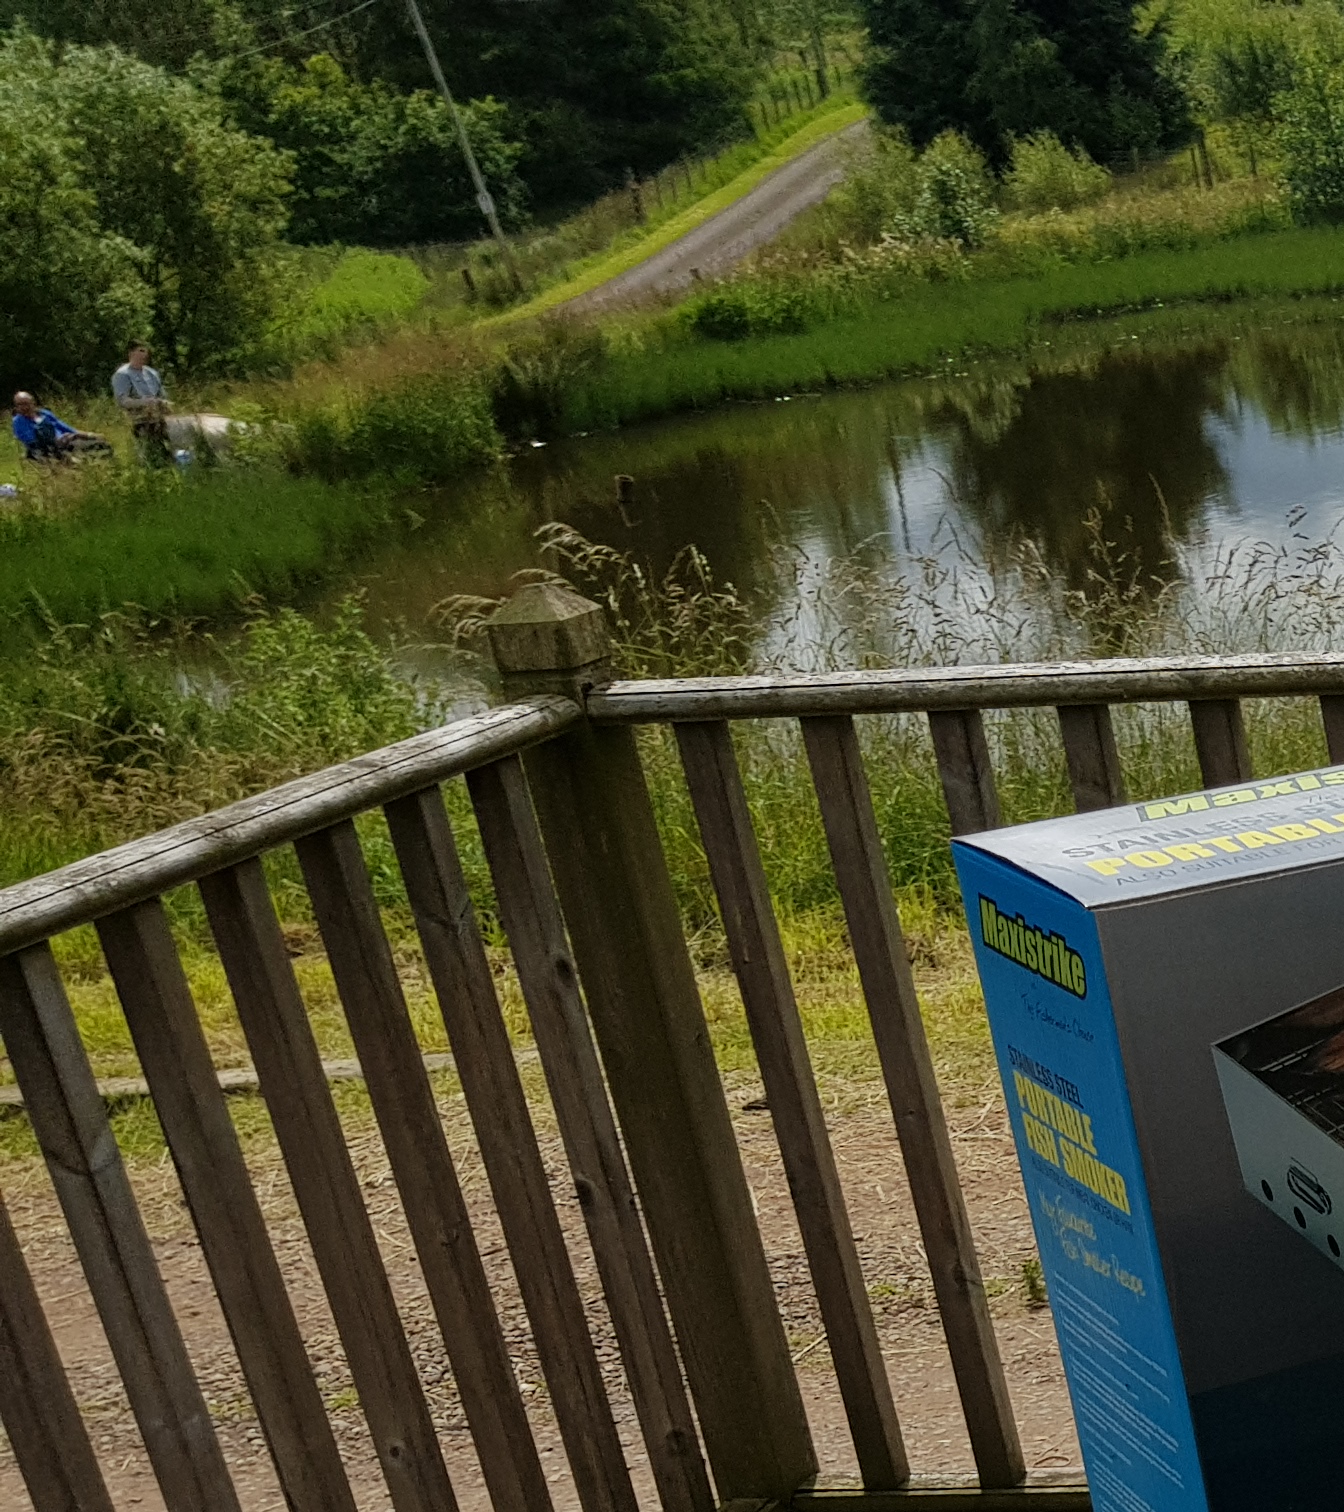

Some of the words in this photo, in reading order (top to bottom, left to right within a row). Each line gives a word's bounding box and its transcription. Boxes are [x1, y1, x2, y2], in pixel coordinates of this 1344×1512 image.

[1061, 811, 1288, 859] STAINLESS
[1115, 868, 1178, 887] ALSO
[1182, 847, 1291, 874] SUITABLE
[1296, 836, 1340, 857] FOR
[980, 895, 1086, 998] Maxistrike
[1008, 1044, 1053, 1090] STAINLESS
[1054, 1070, 1084, 1110] STEEL
[1013, 1069, 1098, 1156] PORTABLE
[1022, 1112, 1060, 1168] FISH
[1059, 1145, 1131, 1216] SMOKER
